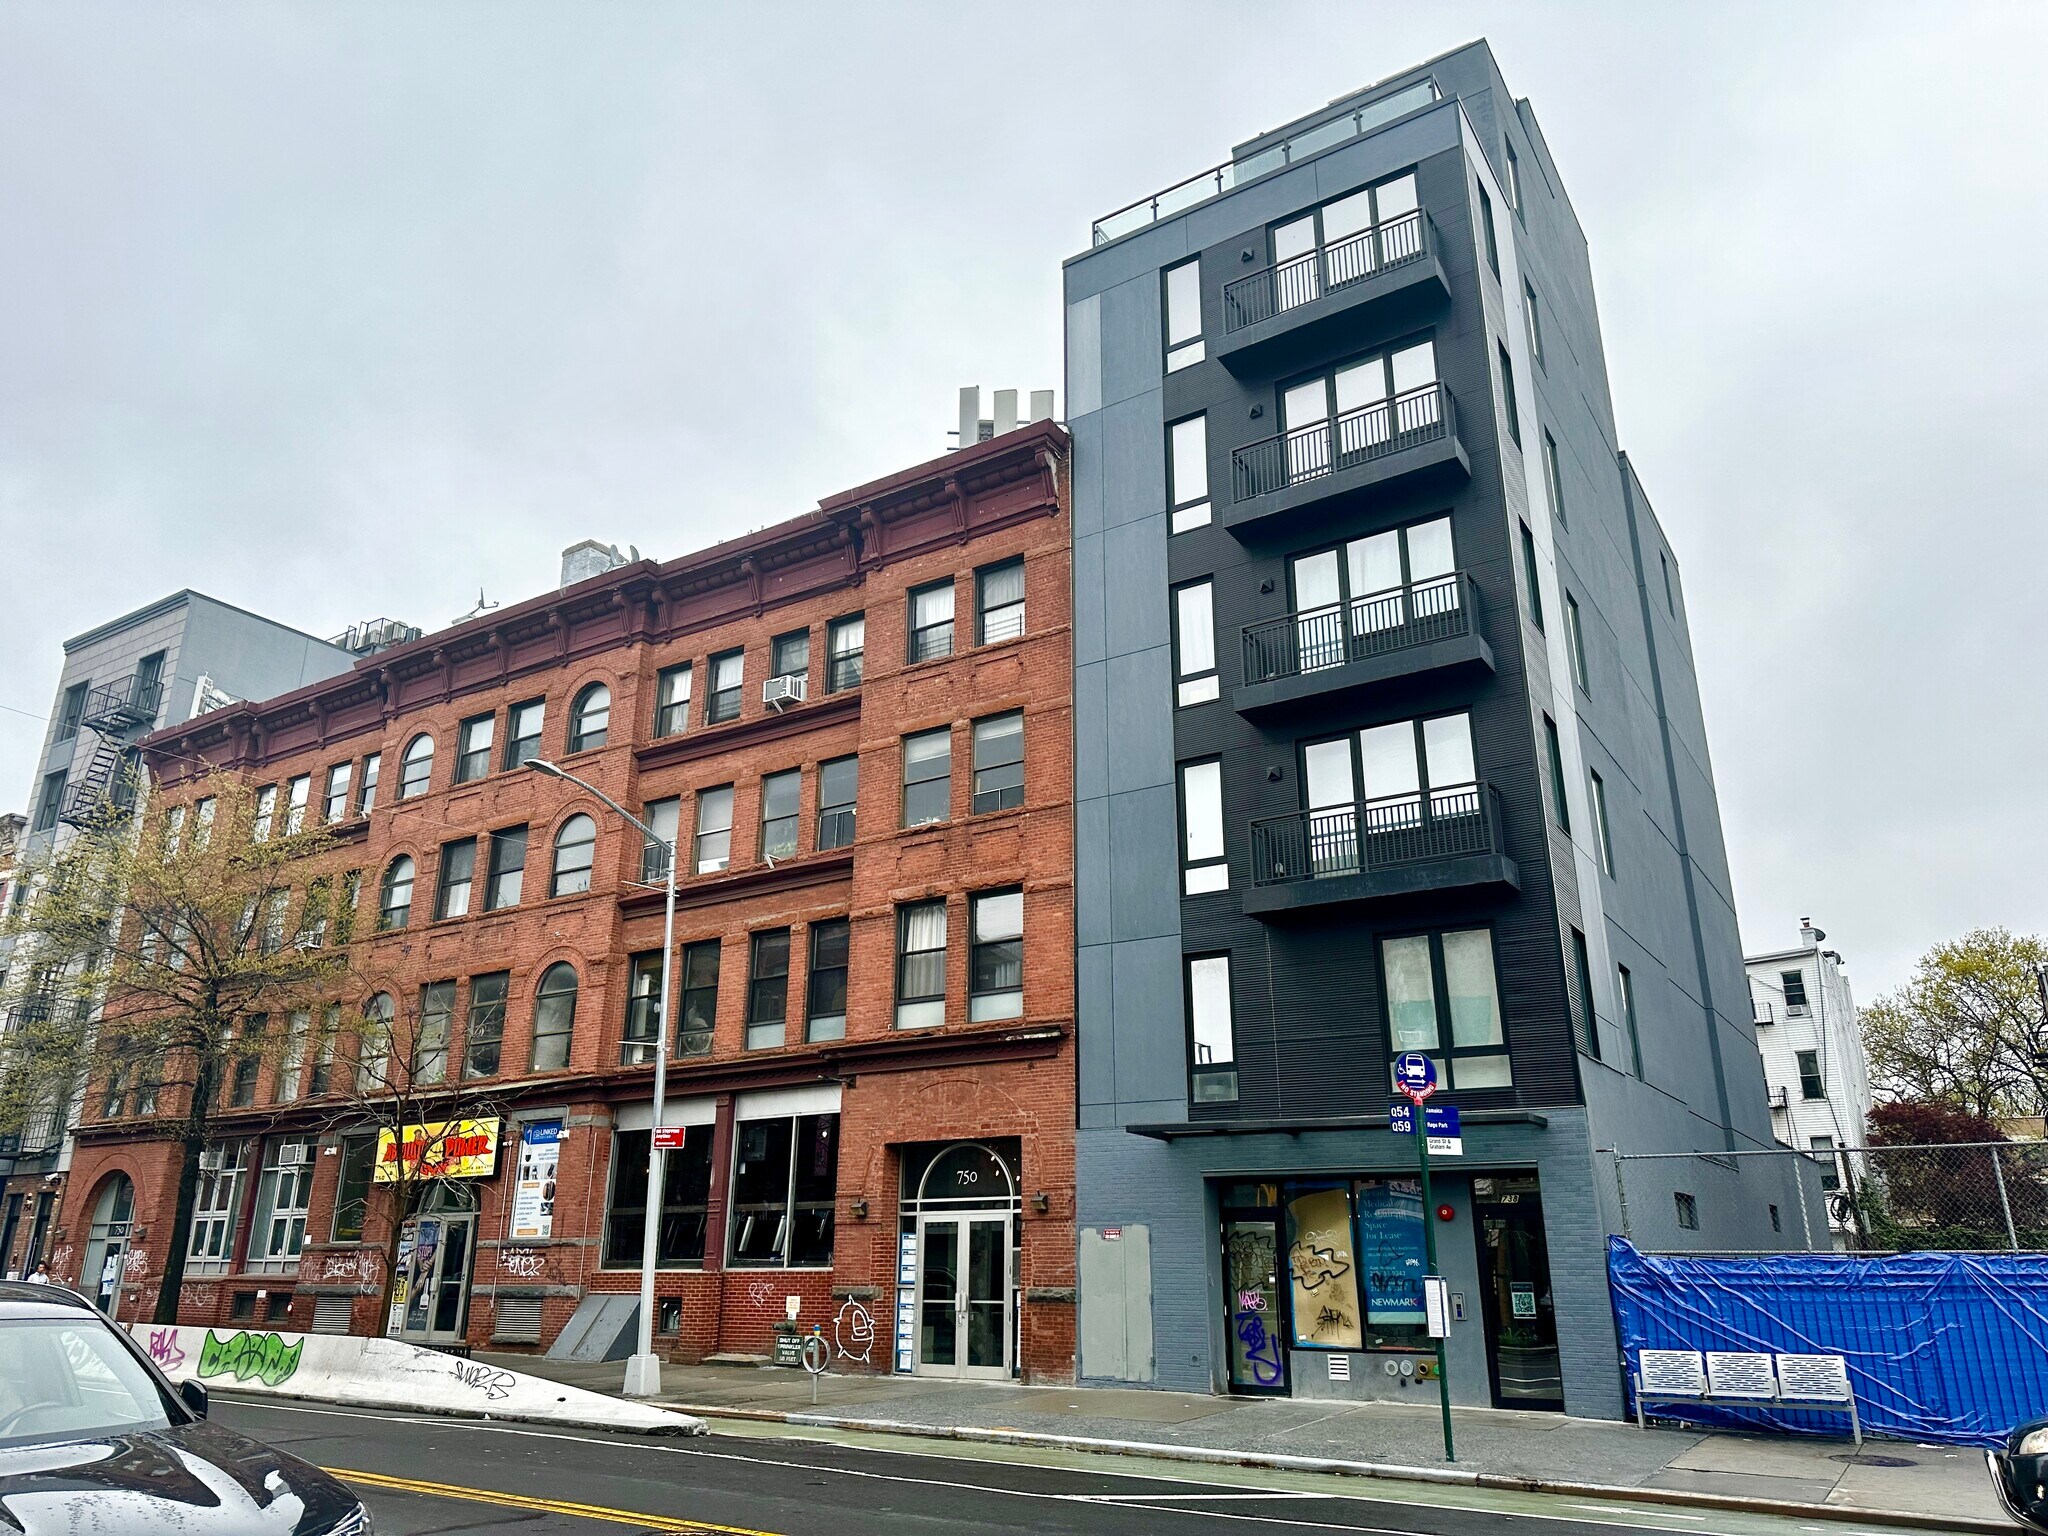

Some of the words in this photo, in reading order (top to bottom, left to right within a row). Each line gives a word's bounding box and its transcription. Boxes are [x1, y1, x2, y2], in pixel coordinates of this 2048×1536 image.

[1400, 1084, 1410, 1093] NO
[1409, 1084, 1435, 1097] STANDING
[1390, 1106, 1410, 1118] Q54
[1392, 1120, 1411, 1132] Q59
[541, 1128, 558, 1136] LINKED
[445, 1135, 494, 1158] POWER
[957, 1170, 978, 1185] 750
[1363, 1199, 1394, 1207] Medical
[1502, 1195, 1519, 1203] 738
[114, 1225, 125, 1235] 750
[1365, 1221, 1388, 1231] Space
[1366, 1231, 1377, 1240] for
[1379, 1231, 1402, 1240] Lease
[1371, 1297, 1417, 1306] NEWMARK
